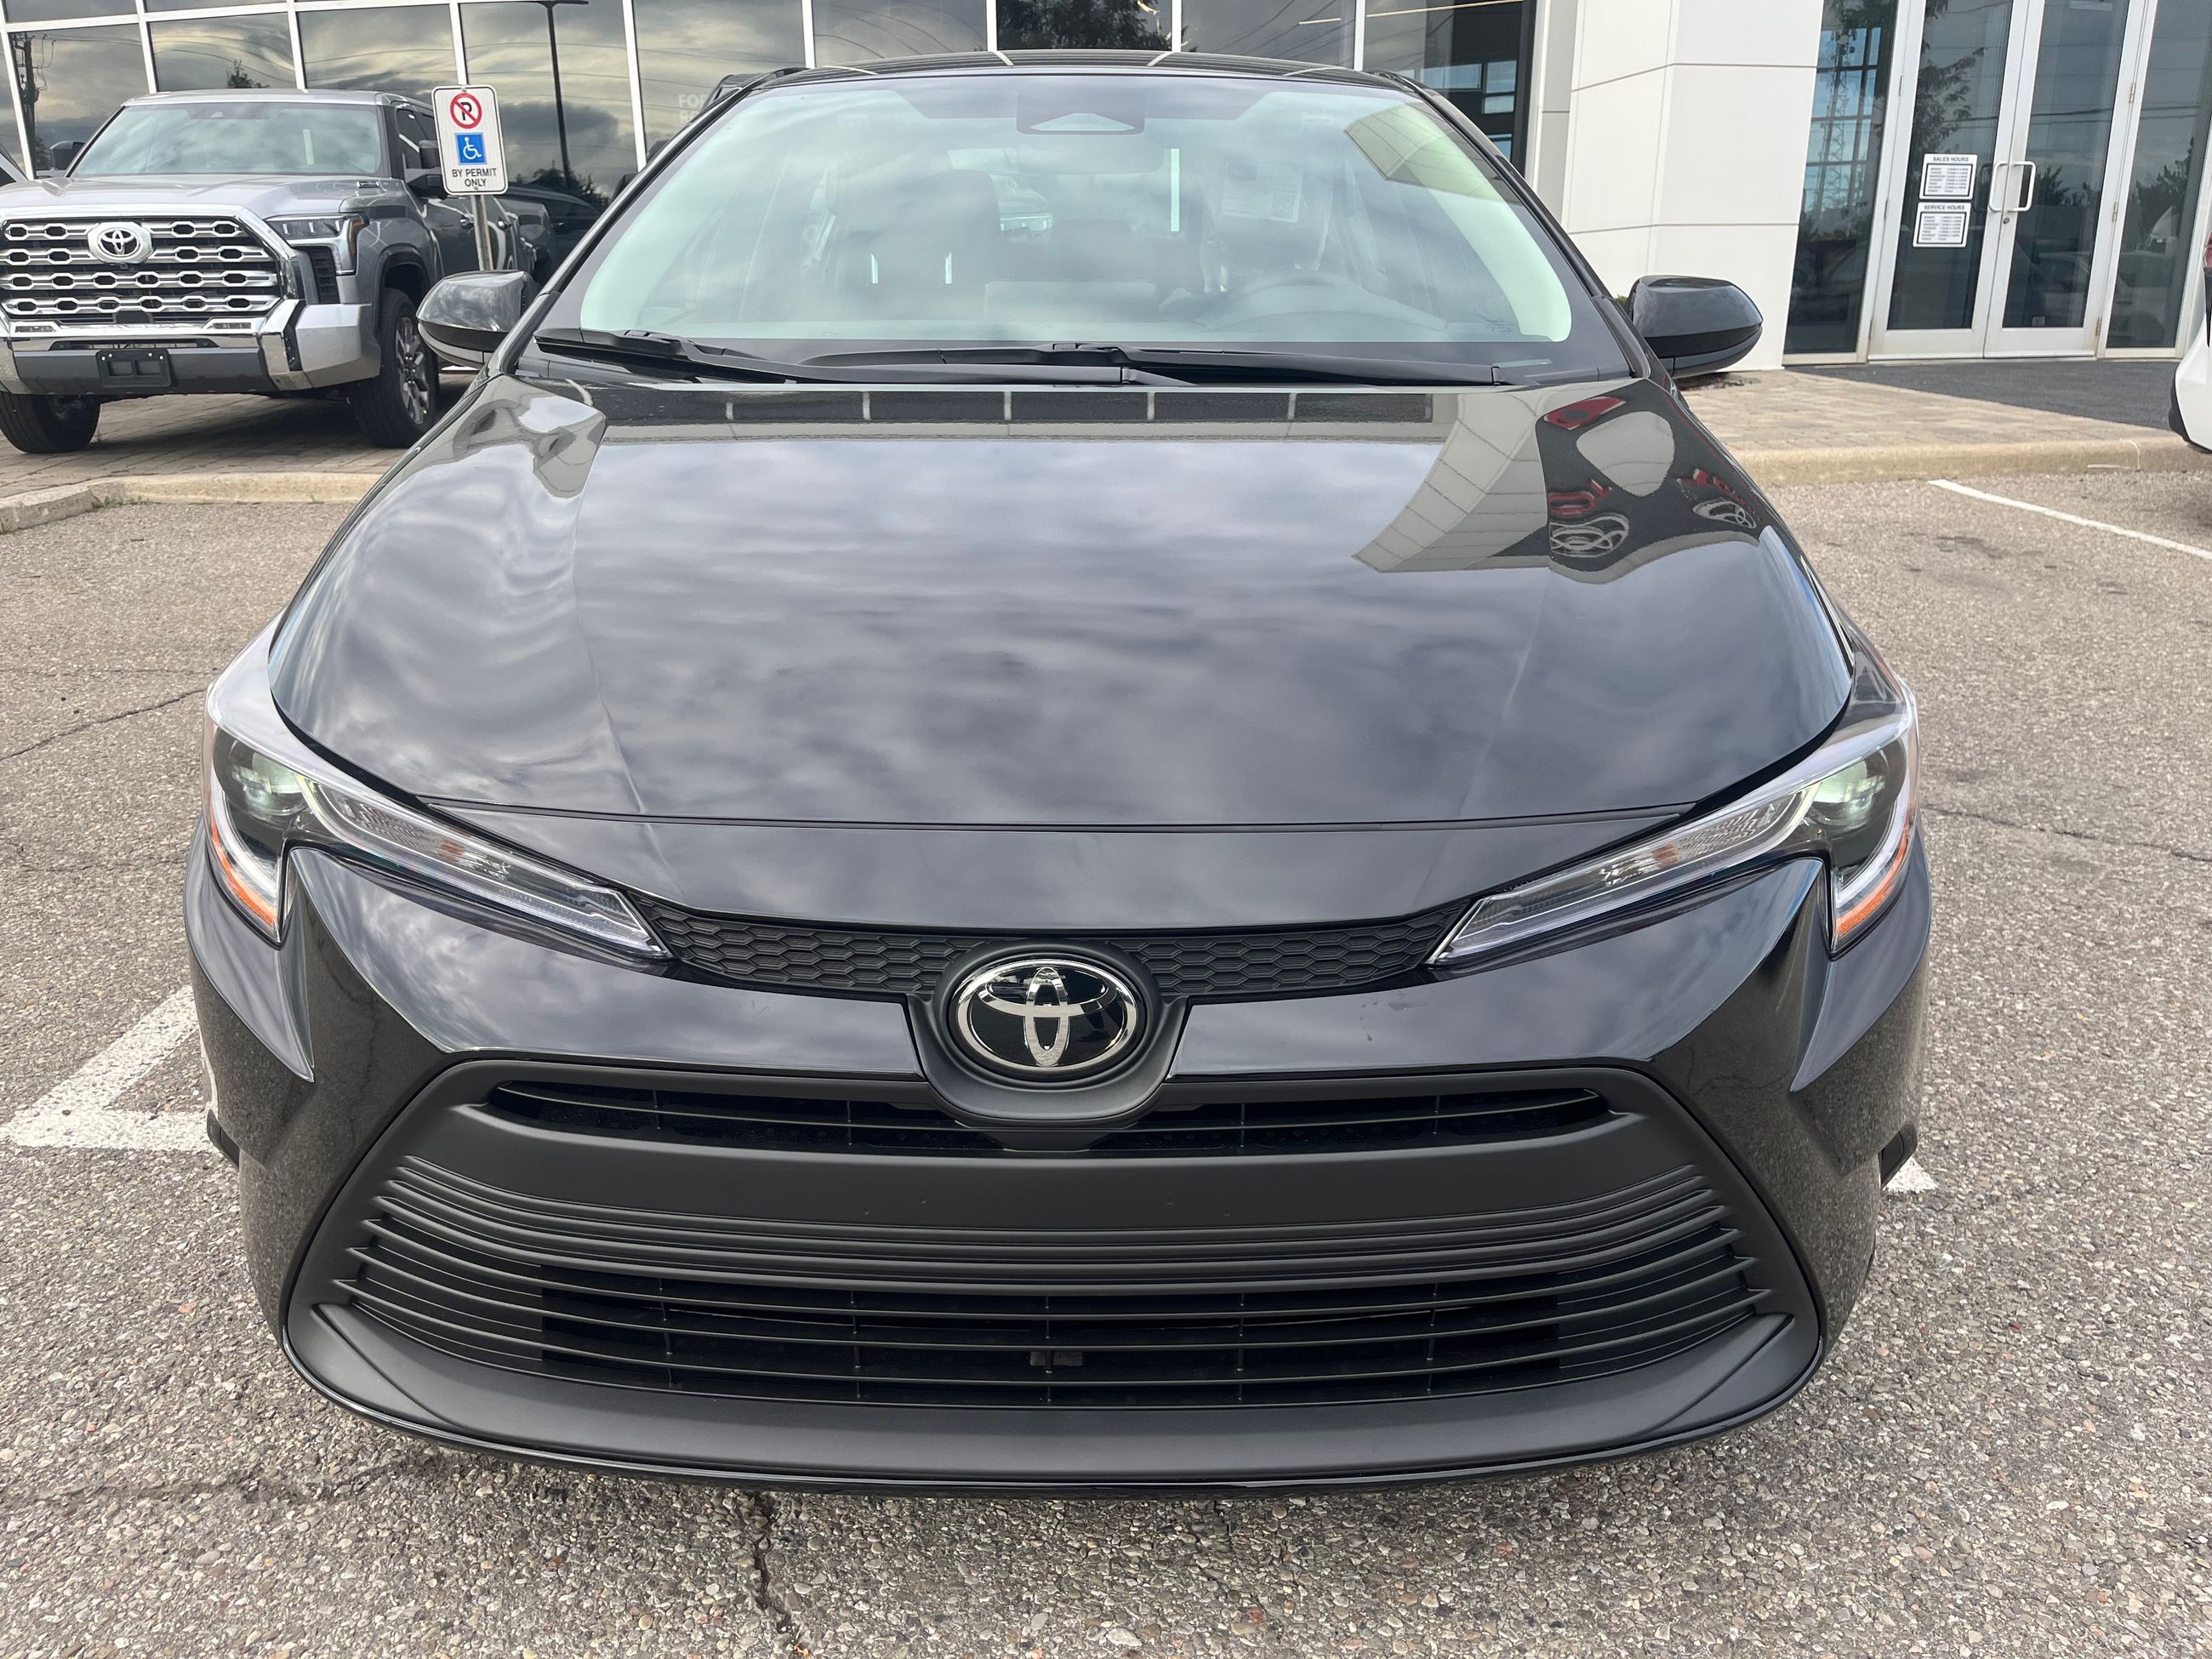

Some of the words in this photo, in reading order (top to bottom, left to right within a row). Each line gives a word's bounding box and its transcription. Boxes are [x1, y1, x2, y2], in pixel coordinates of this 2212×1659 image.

[452, 169, 464, 178] BY
[465, 168, 497, 177] PERMIT
[465, 178, 487, 187] ONLY
